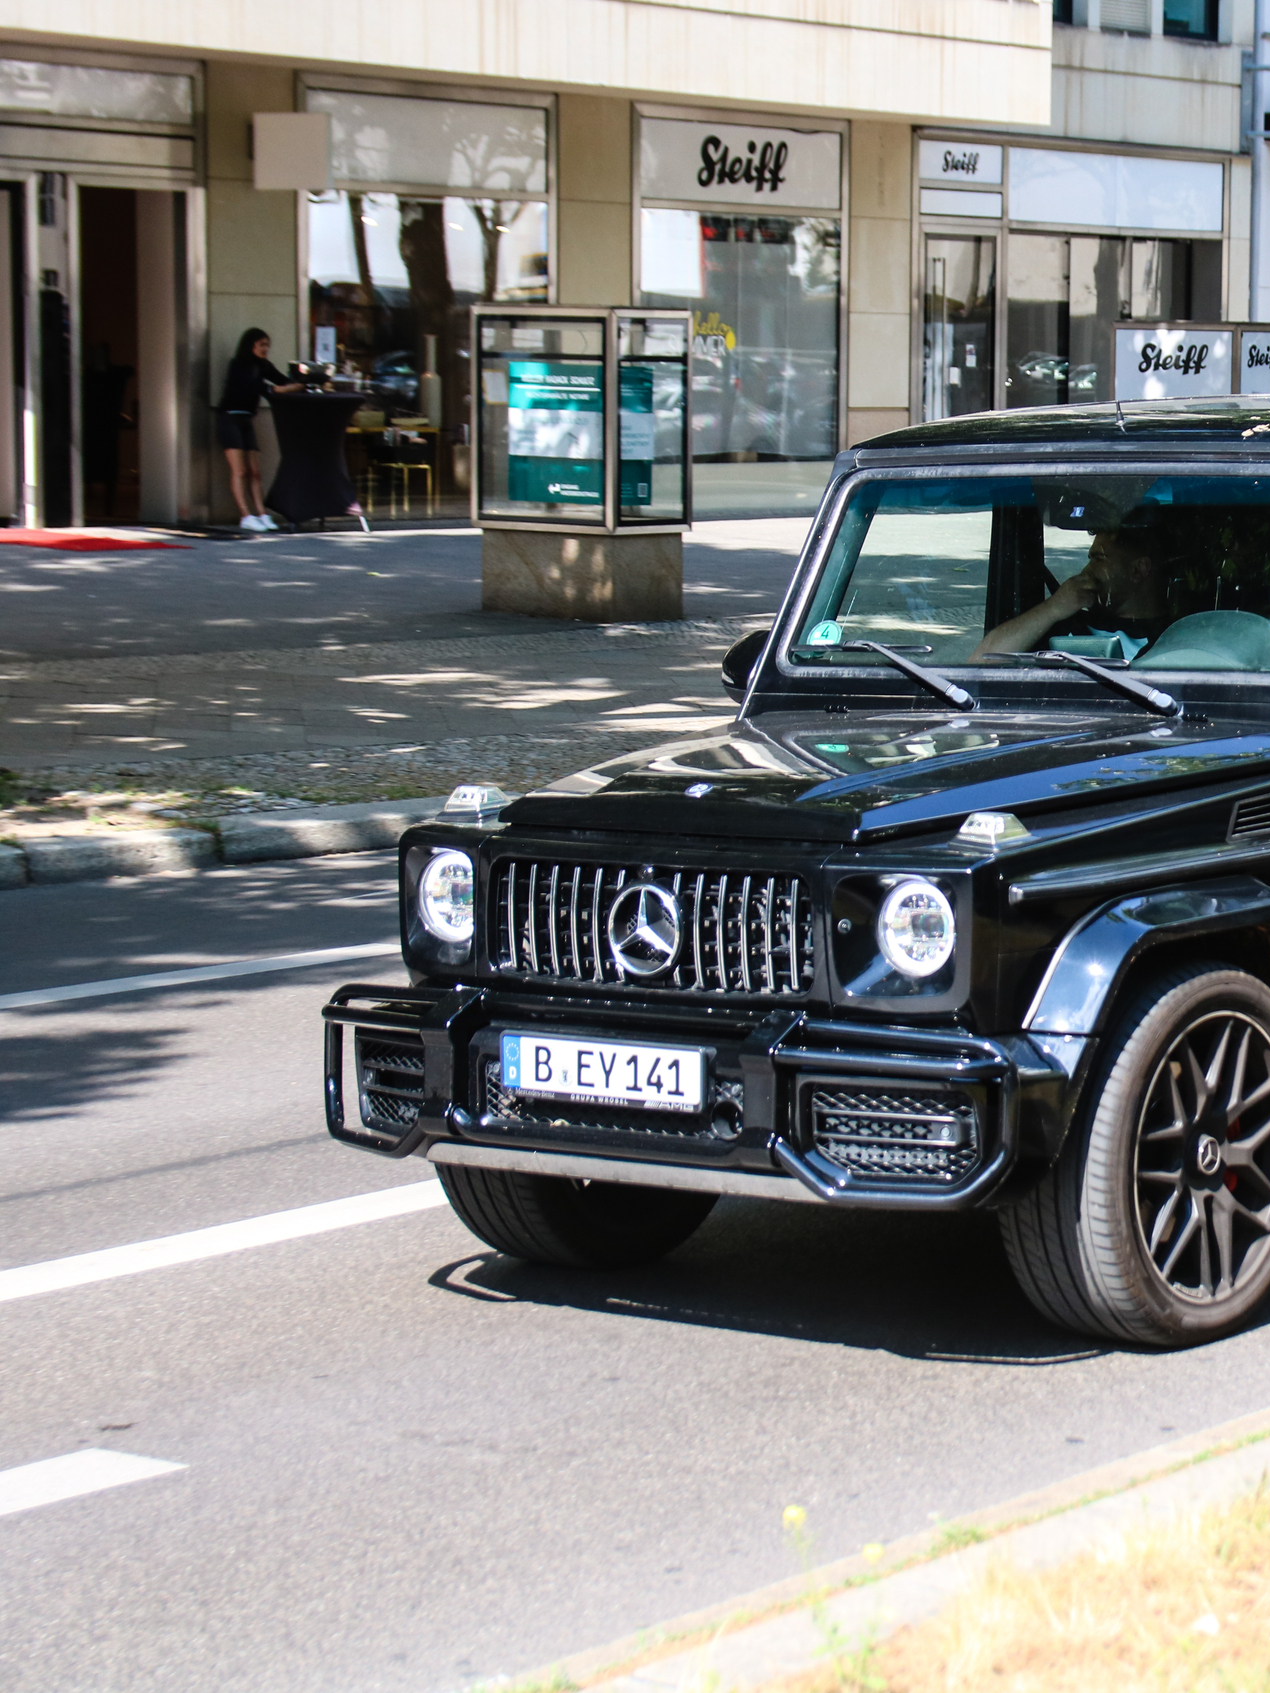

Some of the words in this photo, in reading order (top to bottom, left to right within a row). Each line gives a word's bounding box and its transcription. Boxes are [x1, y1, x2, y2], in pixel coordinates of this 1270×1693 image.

[697, 134, 788, 192] Steiff
[942, 150, 979, 174] Steiff
[1138, 343, 1208, 375] Steiff
[821, 625, 830, 639] 4
[509, 1066, 517, 1079] D
[535, 1045, 552, 1082] B
[570, 1093, 595, 1102] GRUPA
